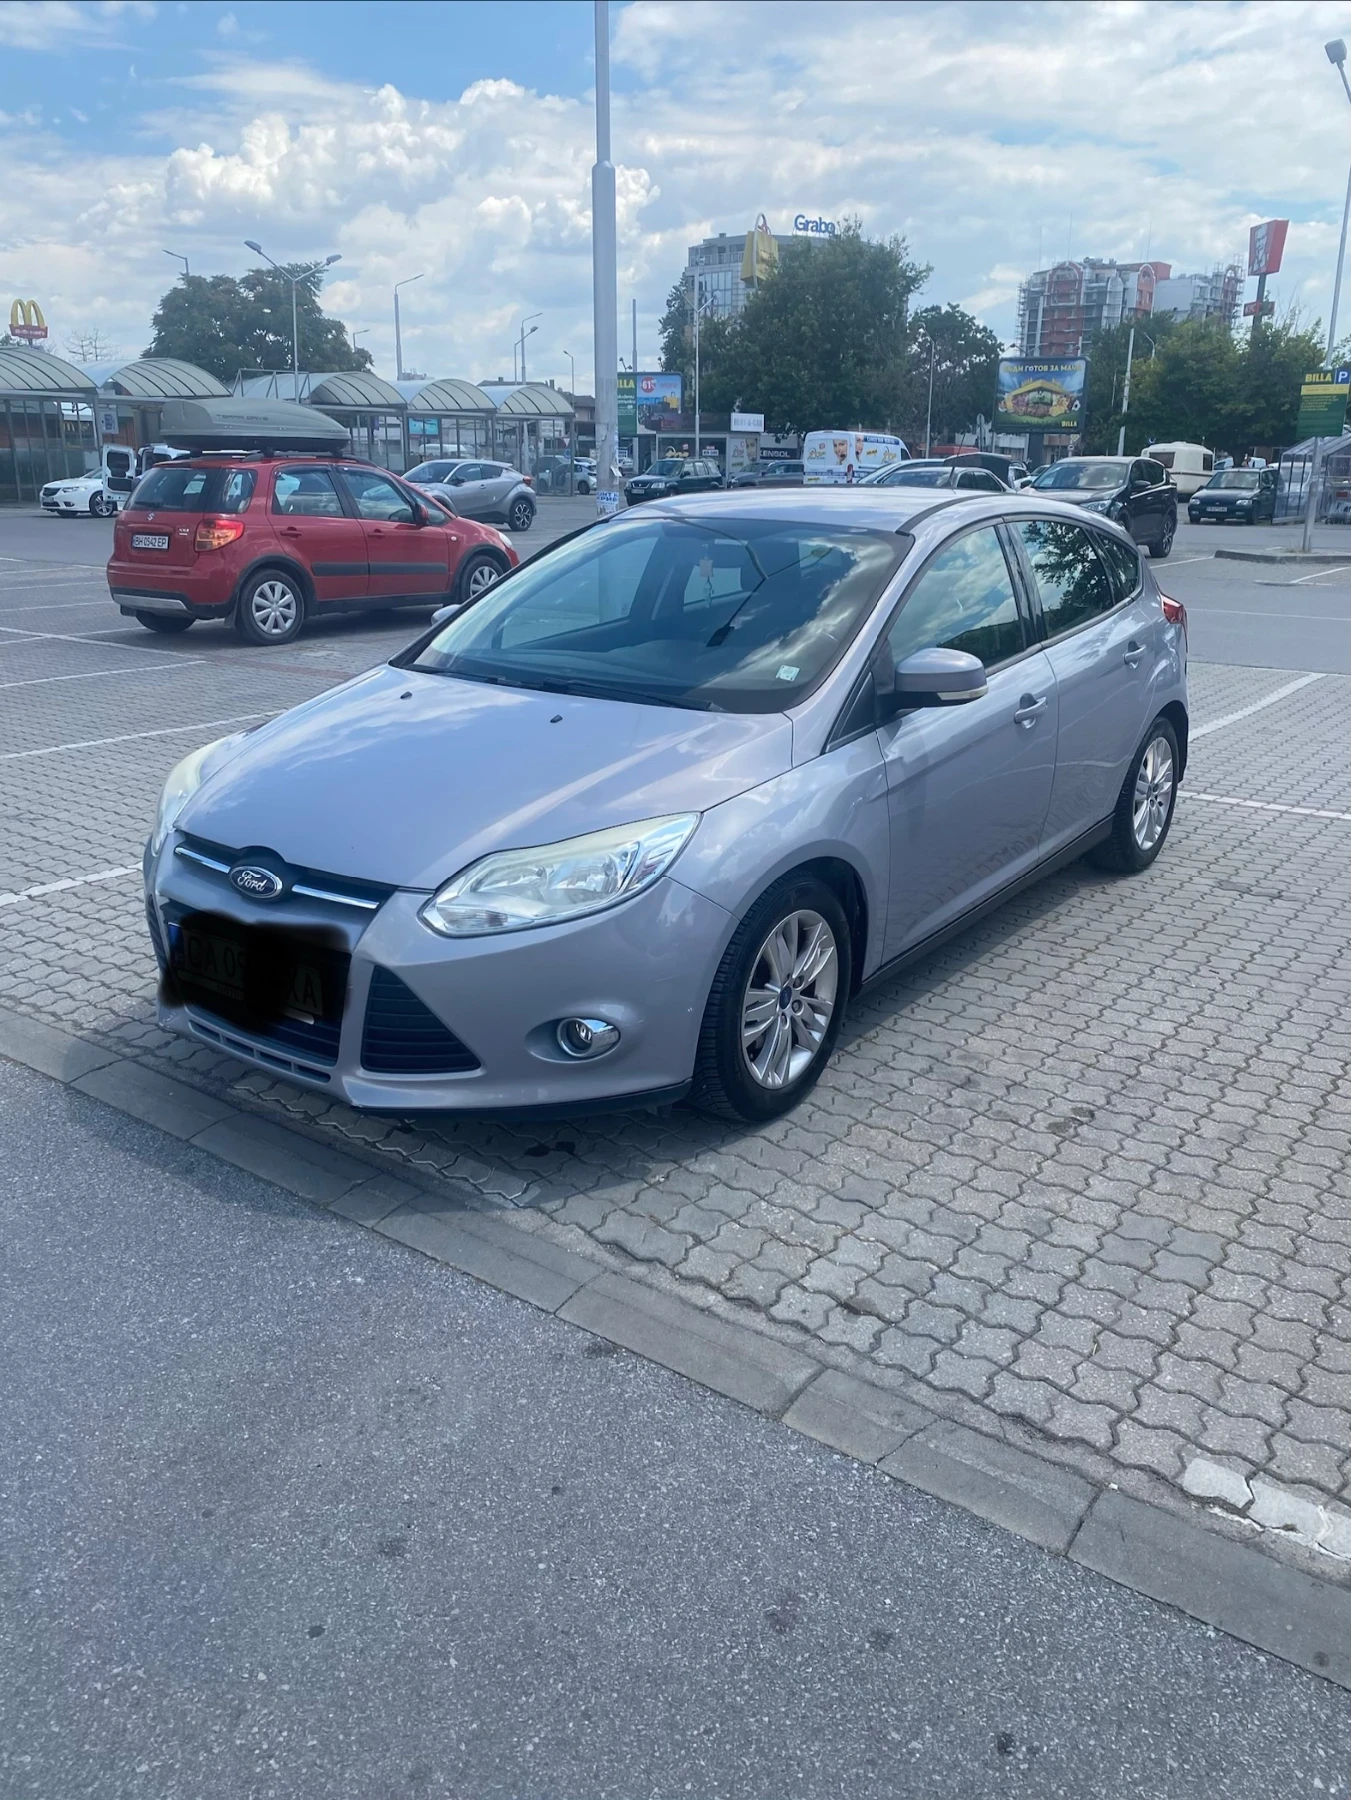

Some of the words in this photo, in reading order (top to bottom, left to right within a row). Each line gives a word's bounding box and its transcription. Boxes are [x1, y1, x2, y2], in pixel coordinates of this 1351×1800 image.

[794, 214, 836, 233] Grabo
[1305, 373, 1332, 382] BILLA
[1338, 371, 1348, 382] P
[617, 379, 635, 388] ILLA
[144, 537, 156, 546] 0542
[157, 538, 167, 547] EP
[237, 870, 268, 892] Ford
